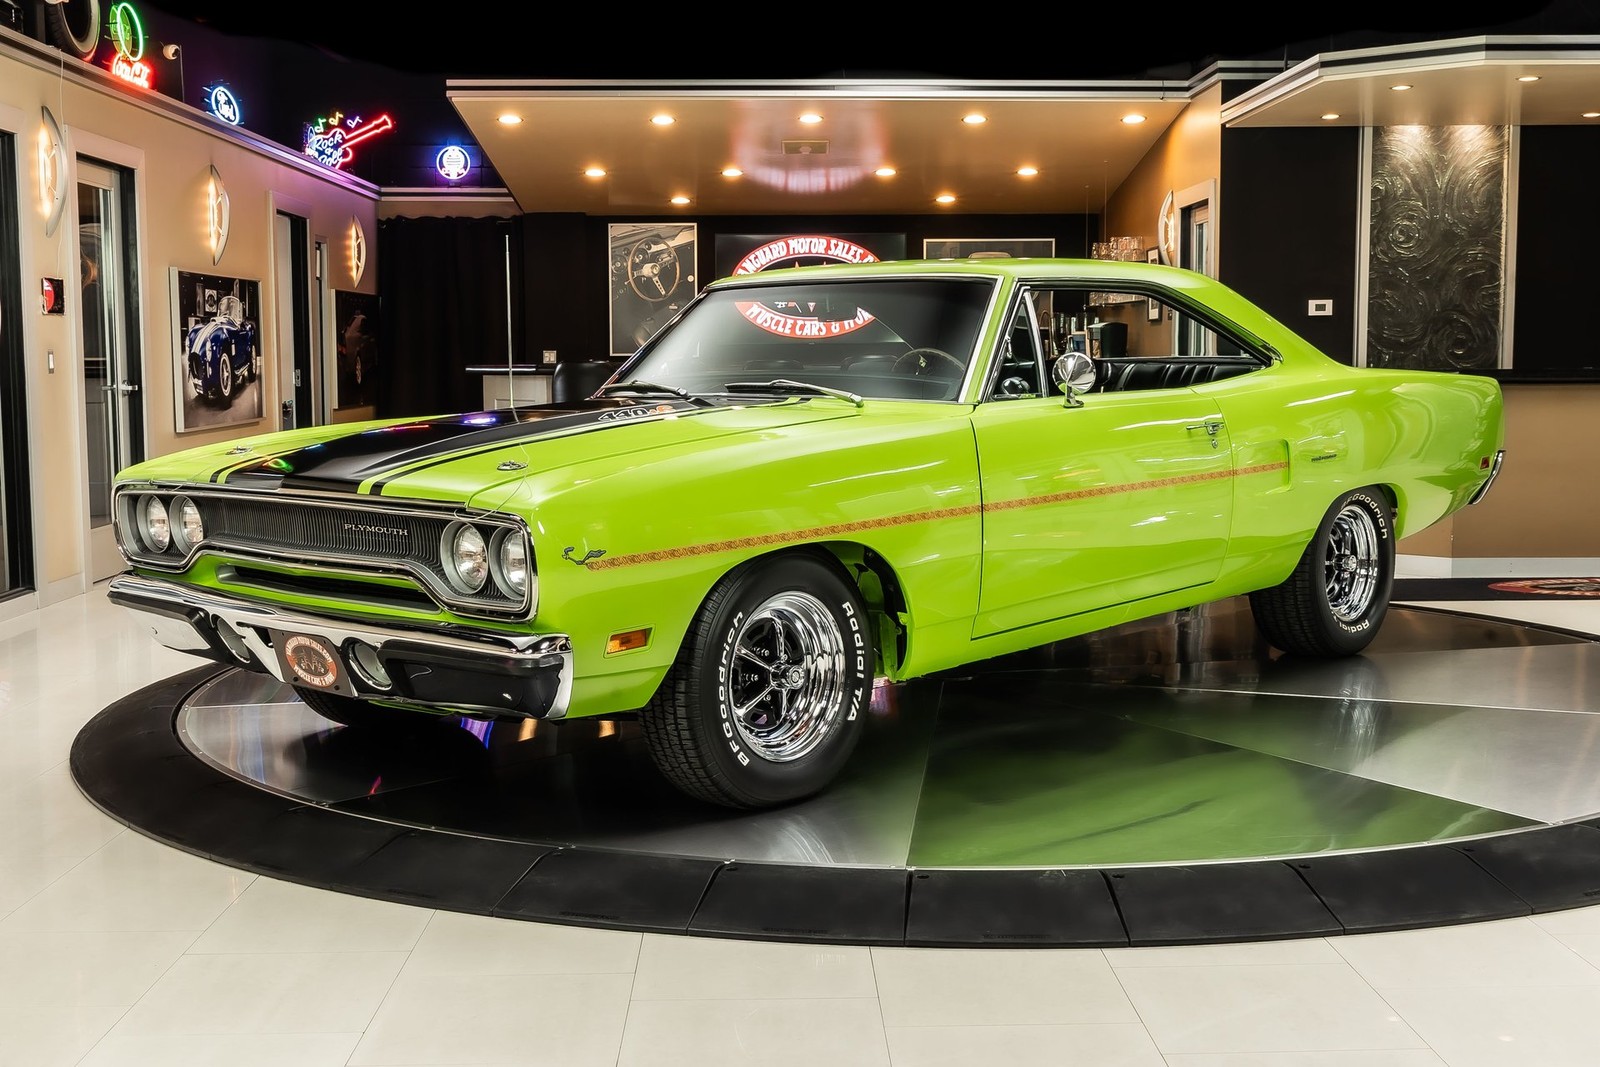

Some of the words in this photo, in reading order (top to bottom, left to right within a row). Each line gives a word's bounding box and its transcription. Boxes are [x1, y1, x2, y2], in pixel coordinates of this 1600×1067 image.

[314, 129, 343, 151] Rock
[736, 241, 788, 274] ANGUARD
[787, 238, 828, 255] MOTOR
[745, 303, 794, 334] MUSCLE
[795, 320, 827, 336] CARS
[344, 523, 409, 536] PLYMOUTH
[841, 601, 865, 679] Radial
[718, 611, 750, 767] BFGoodrich
[847, 687, 863, 721] T/A
